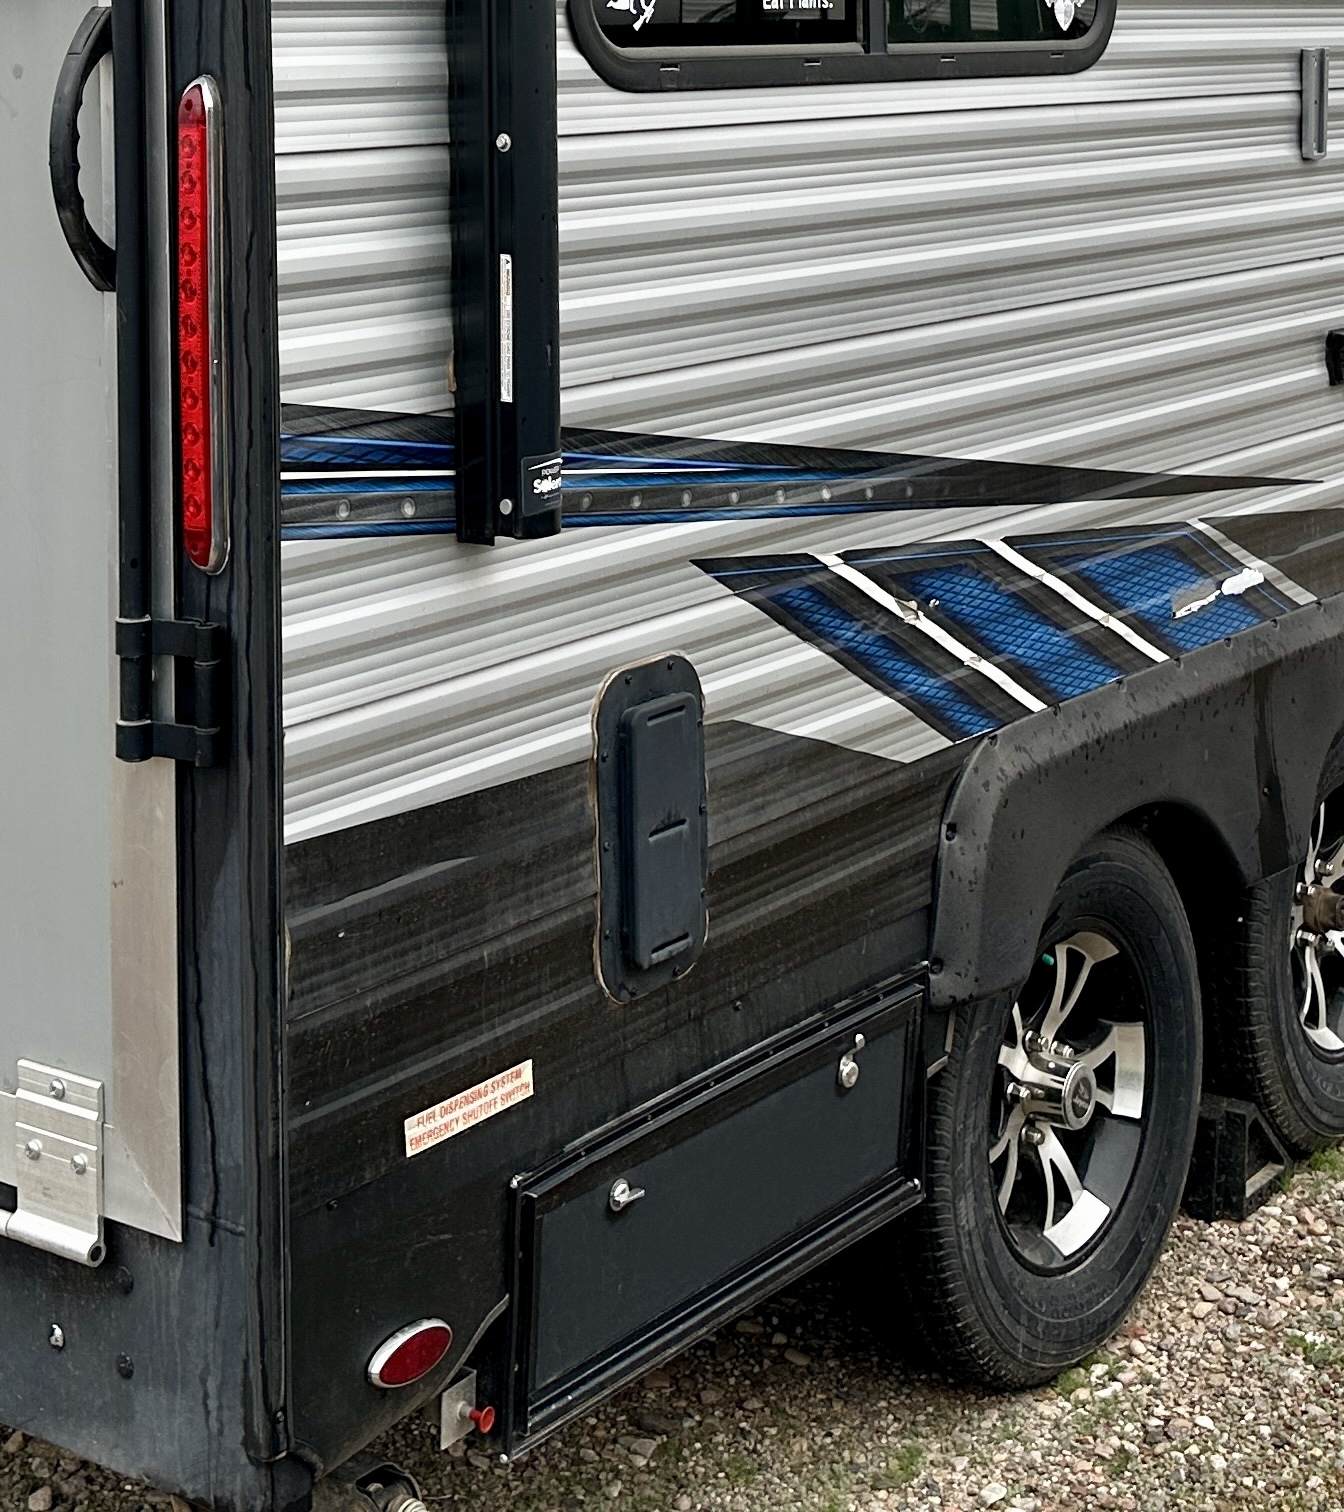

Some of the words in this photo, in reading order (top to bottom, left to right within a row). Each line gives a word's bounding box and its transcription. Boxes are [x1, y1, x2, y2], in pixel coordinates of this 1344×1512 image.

[409, 1115, 460, 1151] EMERGENCY
[462, 1096, 498, 1125] SHUTOFF
[500, 1081, 531, 1106] SWITCH
[417, 1109, 437, 1129] FUEL
[440, 1084, 489, 1118] DISPENSING
[490, 1068, 522, 1094] SYSTEM
